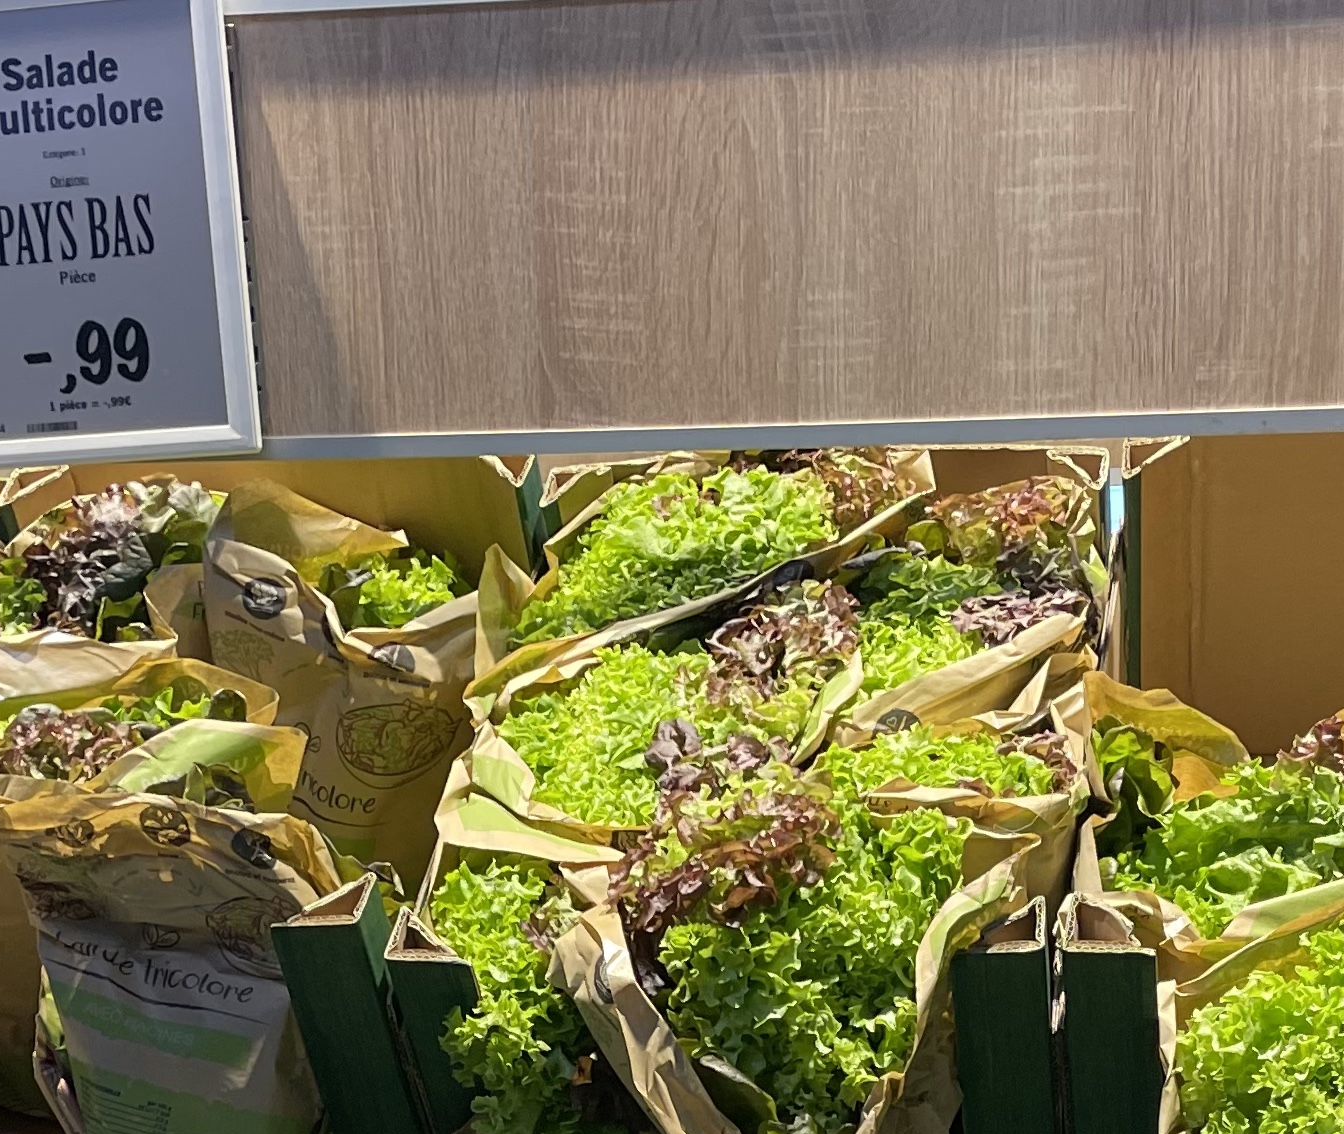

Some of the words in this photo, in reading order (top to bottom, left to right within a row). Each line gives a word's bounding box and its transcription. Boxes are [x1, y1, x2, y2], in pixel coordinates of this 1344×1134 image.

[0, 50, 118, 92] Salade
[84, 193, 156, 260] BAS
[59, 269, 96, 285] Pièce
[23, 317, 150, 394] -,99
